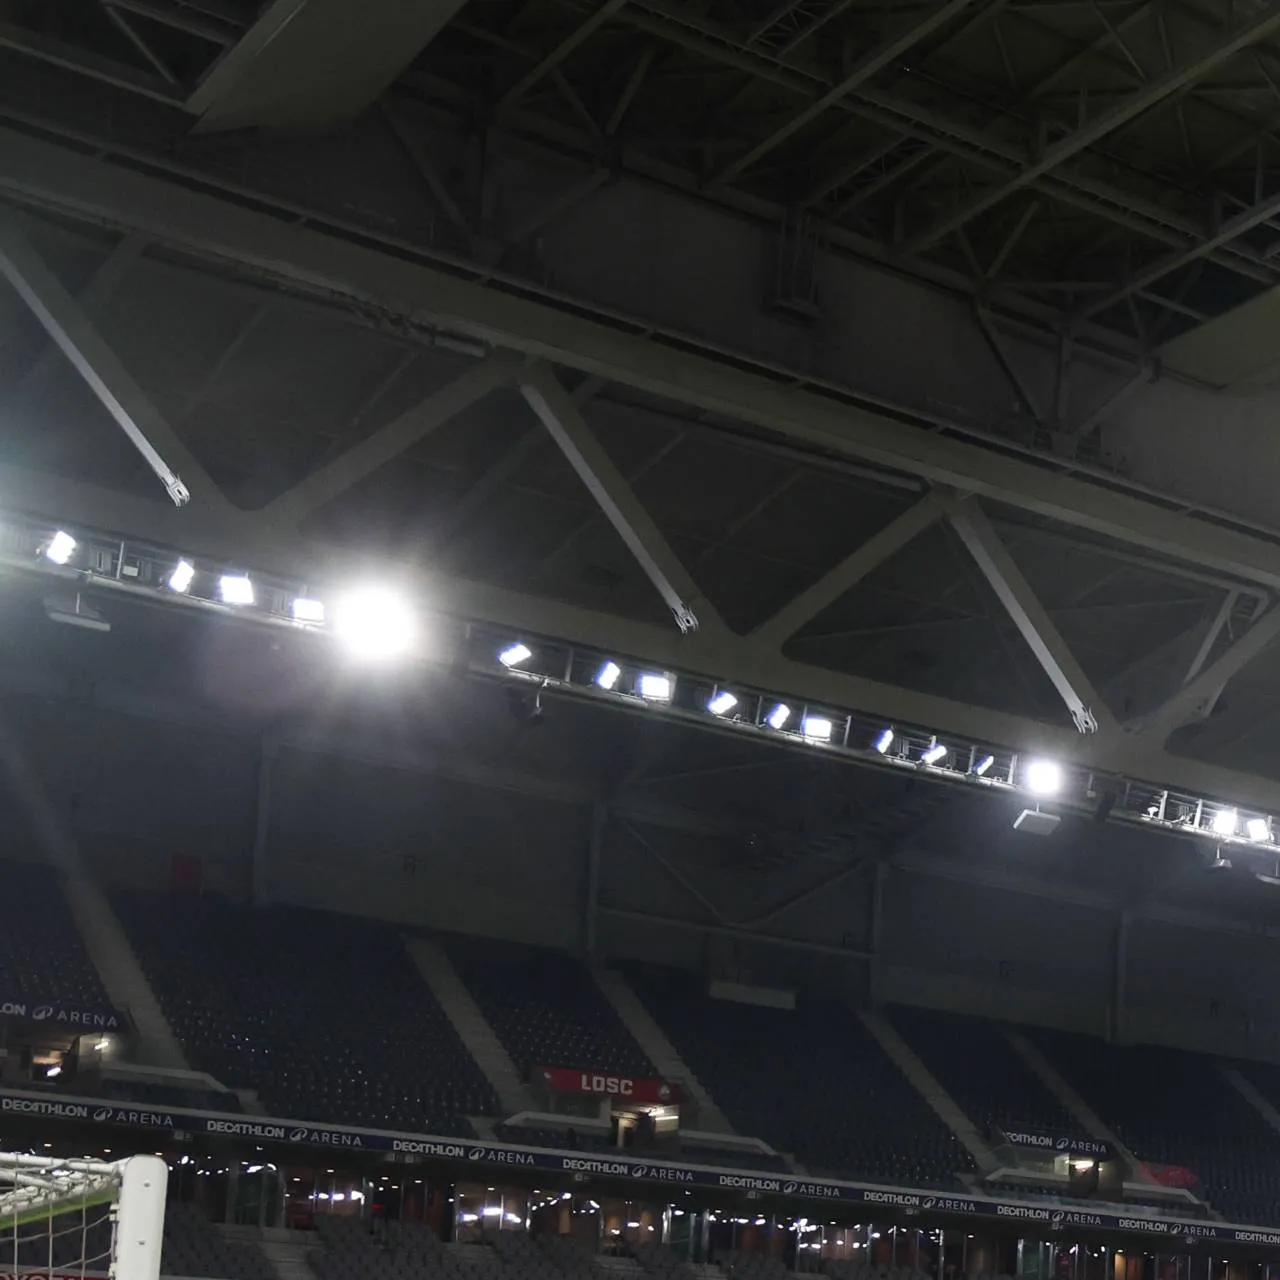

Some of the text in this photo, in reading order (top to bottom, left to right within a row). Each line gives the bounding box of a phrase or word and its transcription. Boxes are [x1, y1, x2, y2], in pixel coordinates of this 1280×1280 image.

[57, 1010, 118, 1028] ARENA
[581, 1074, 633, 1095] LOSC
[2, 1099, 174, 1127] DECATHLON ARENA
[207, 1120, 362, 1147] DECATHLON ARENA
[393, 1140, 535, 1165] DECATHLON ARENA
[1070, 1140, 1107, 1153] ARENA
[563, 1158, 694, 1182] DECATHLON ARENA
[719, 1175, 841, 1198] DECATHLON ARENA
[863, 1191, 976, 1212] DECATHLON ARENA
[996, 1205, 1102, 1226] DECATHLON ARENA
[1118, 1218, 1217, 1238] DECATHLON ARENA
[1235, 1231, 1280, 1245] DECATHLON
